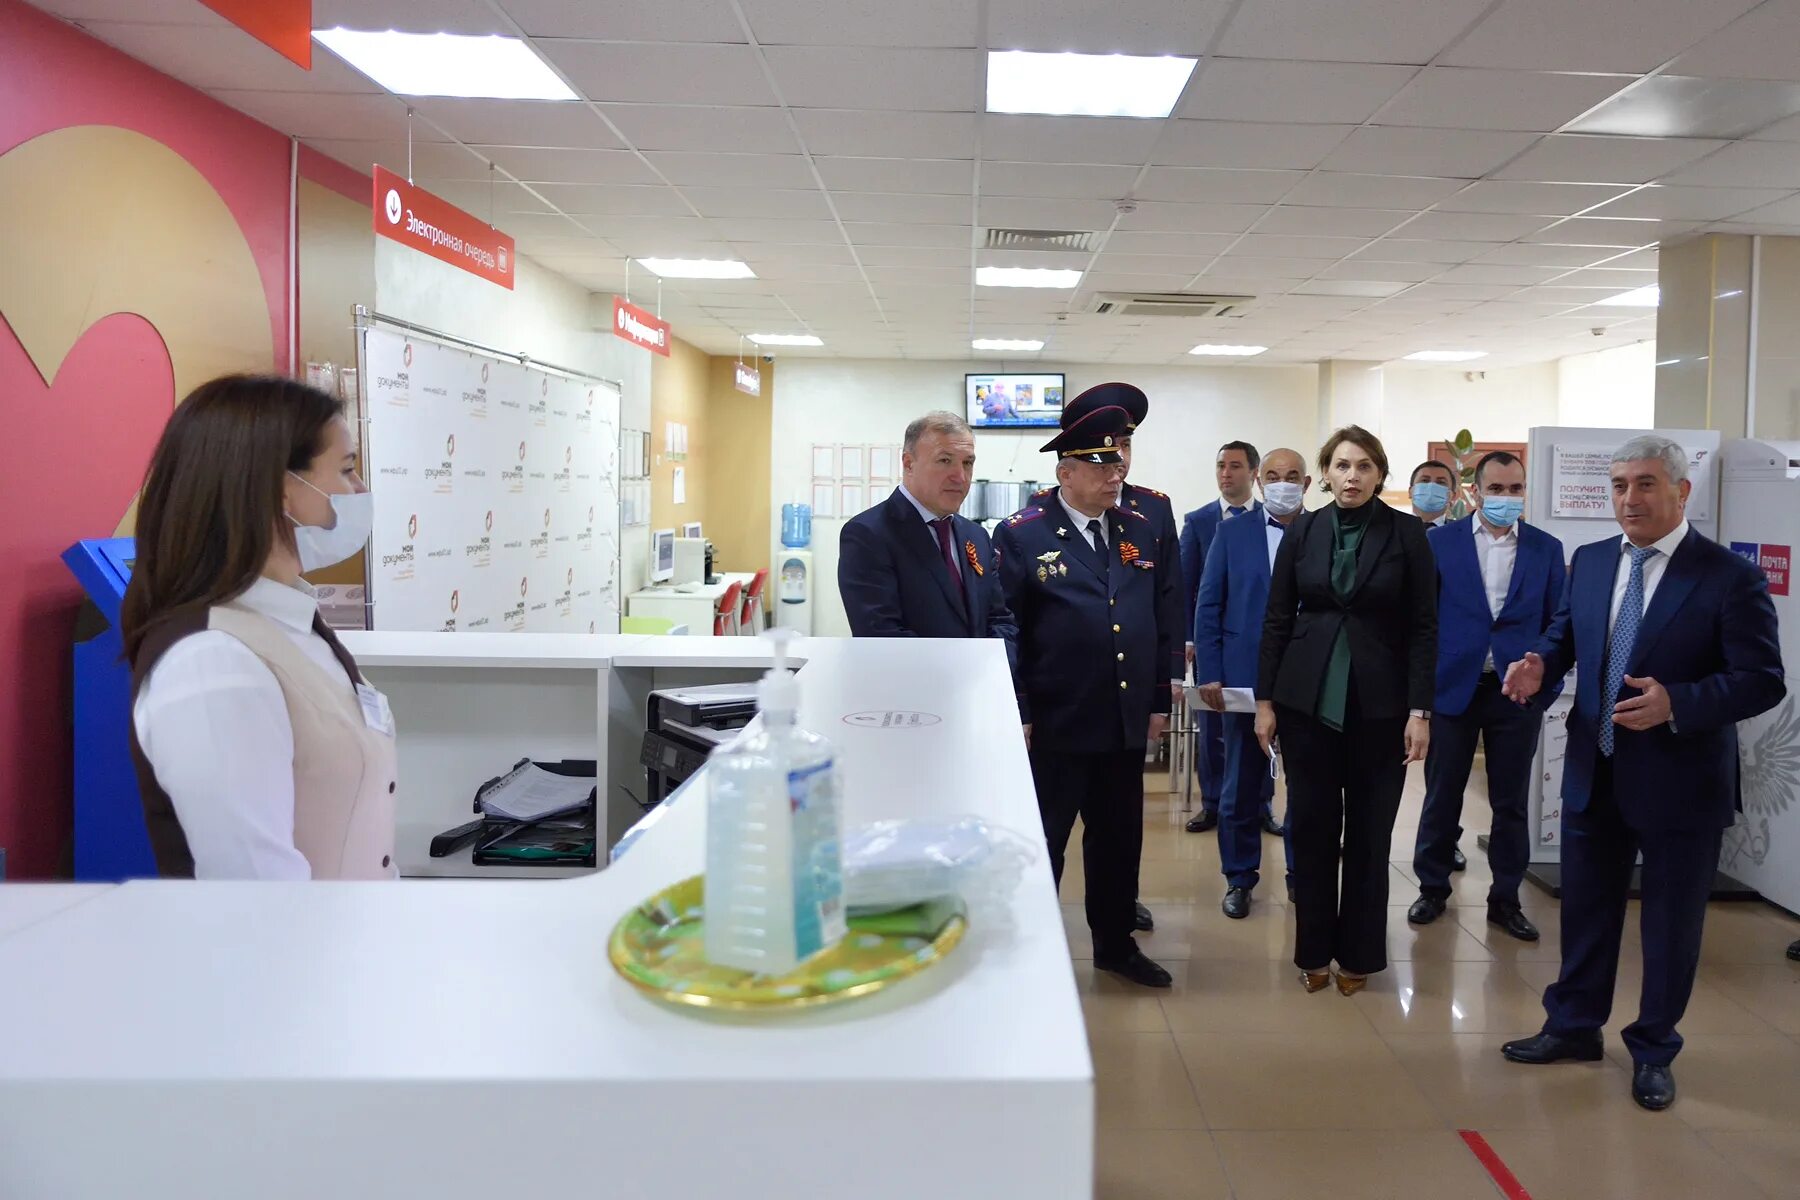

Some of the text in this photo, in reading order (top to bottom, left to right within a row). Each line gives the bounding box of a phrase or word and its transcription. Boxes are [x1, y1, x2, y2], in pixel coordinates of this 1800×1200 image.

[406, 209, 496, 270] Электронная очередь
[1560, 485, 1606, 494] ПОЛУЧИТЕ
[1560, 501, 1605, 509] ВЫПЛАТУ!
[1761, 556, 1788, 570] ПОЧТА
[1766, 571, 1784, 585] АНК
